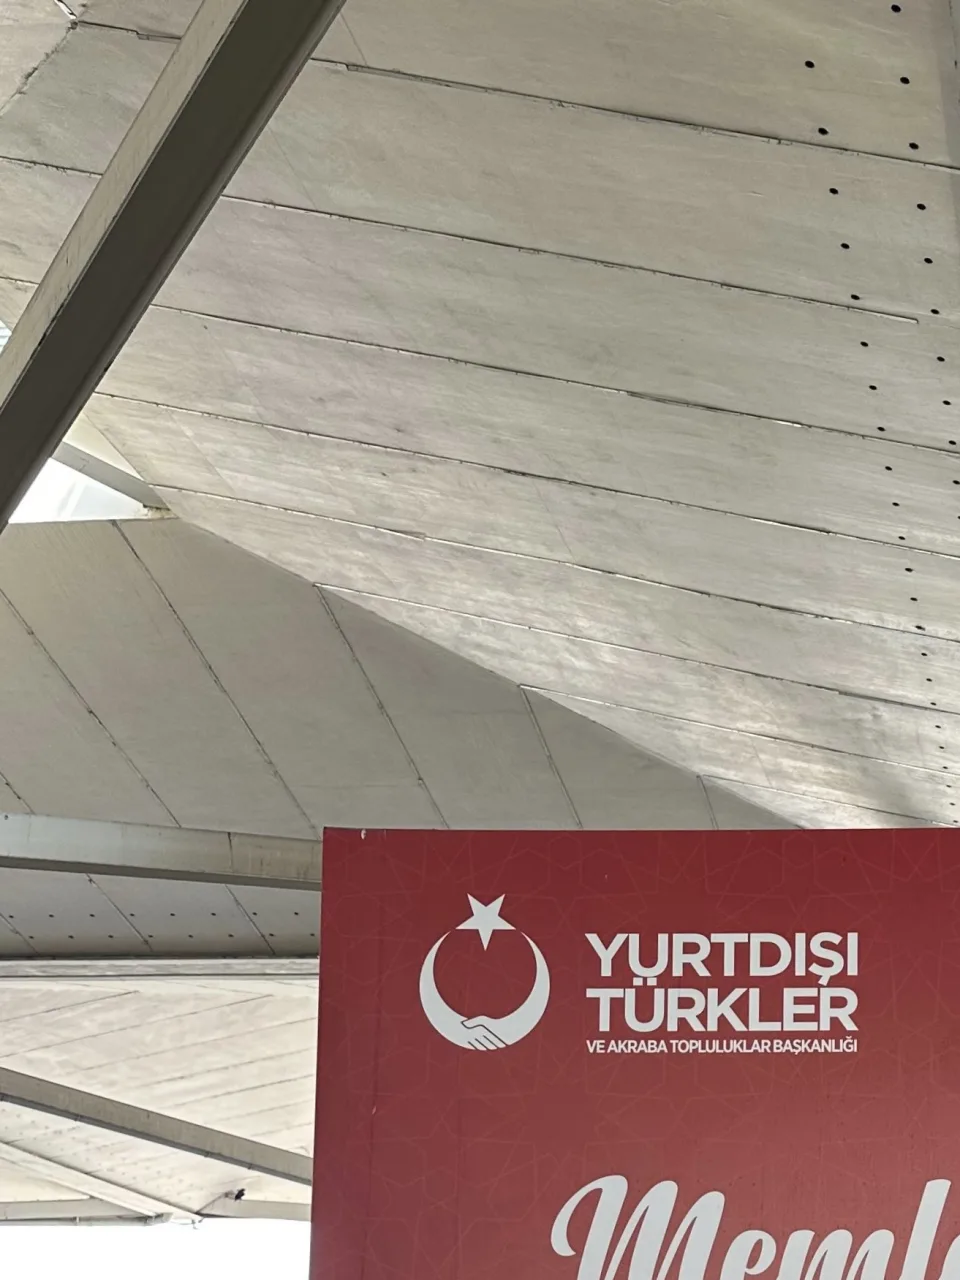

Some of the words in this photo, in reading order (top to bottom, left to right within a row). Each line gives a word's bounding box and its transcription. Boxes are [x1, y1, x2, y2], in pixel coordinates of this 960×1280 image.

[585, 932, 858, 986] YURTDIŞI
[586, 977, 859, 1032] TÜRKLER
[586, 1039, 606, 1054] VE
[607, 1039, 668, 1054] AKRABA
[669, 1039, 772, 1054] TOPLULUKLAR
[773, 1035, 858, 1056] BAŞKANLIĞI
